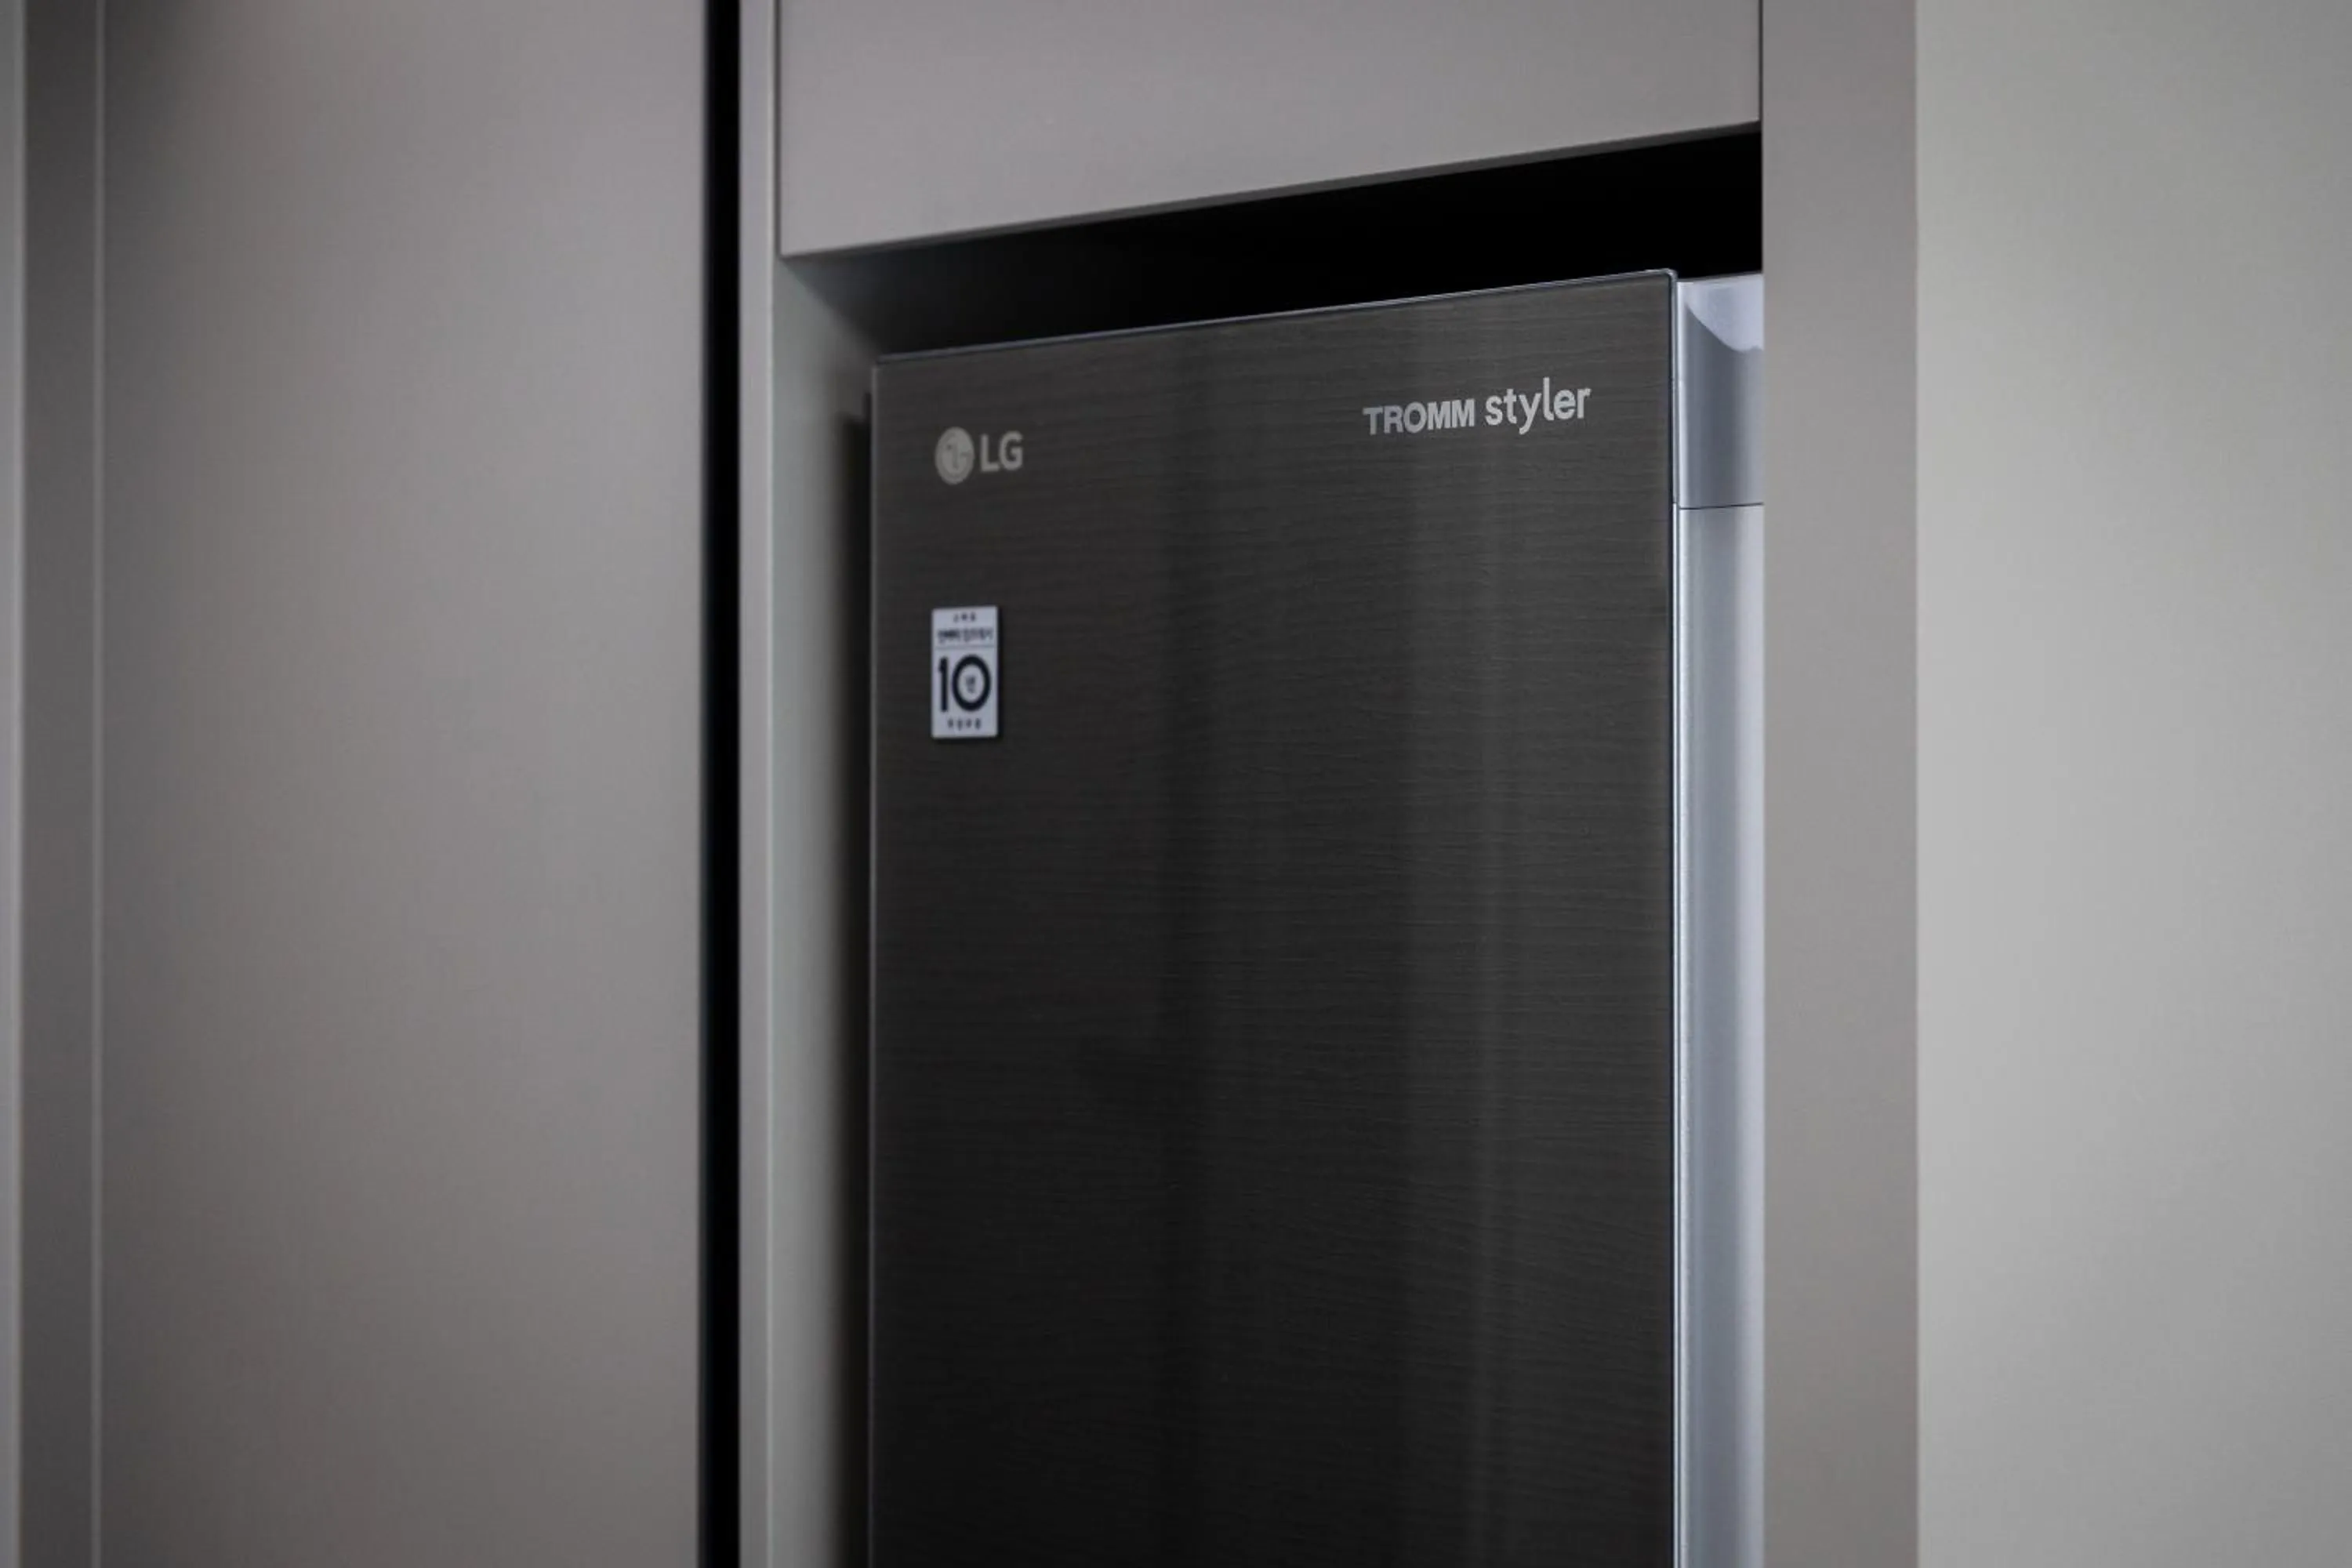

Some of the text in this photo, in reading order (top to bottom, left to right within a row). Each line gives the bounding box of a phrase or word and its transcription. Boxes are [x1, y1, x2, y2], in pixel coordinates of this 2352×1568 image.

[1363, 377, 1592, 435] TROMM styler
[981, 430, 1023, 472] LG
[938, 654, 991, 713] 10
